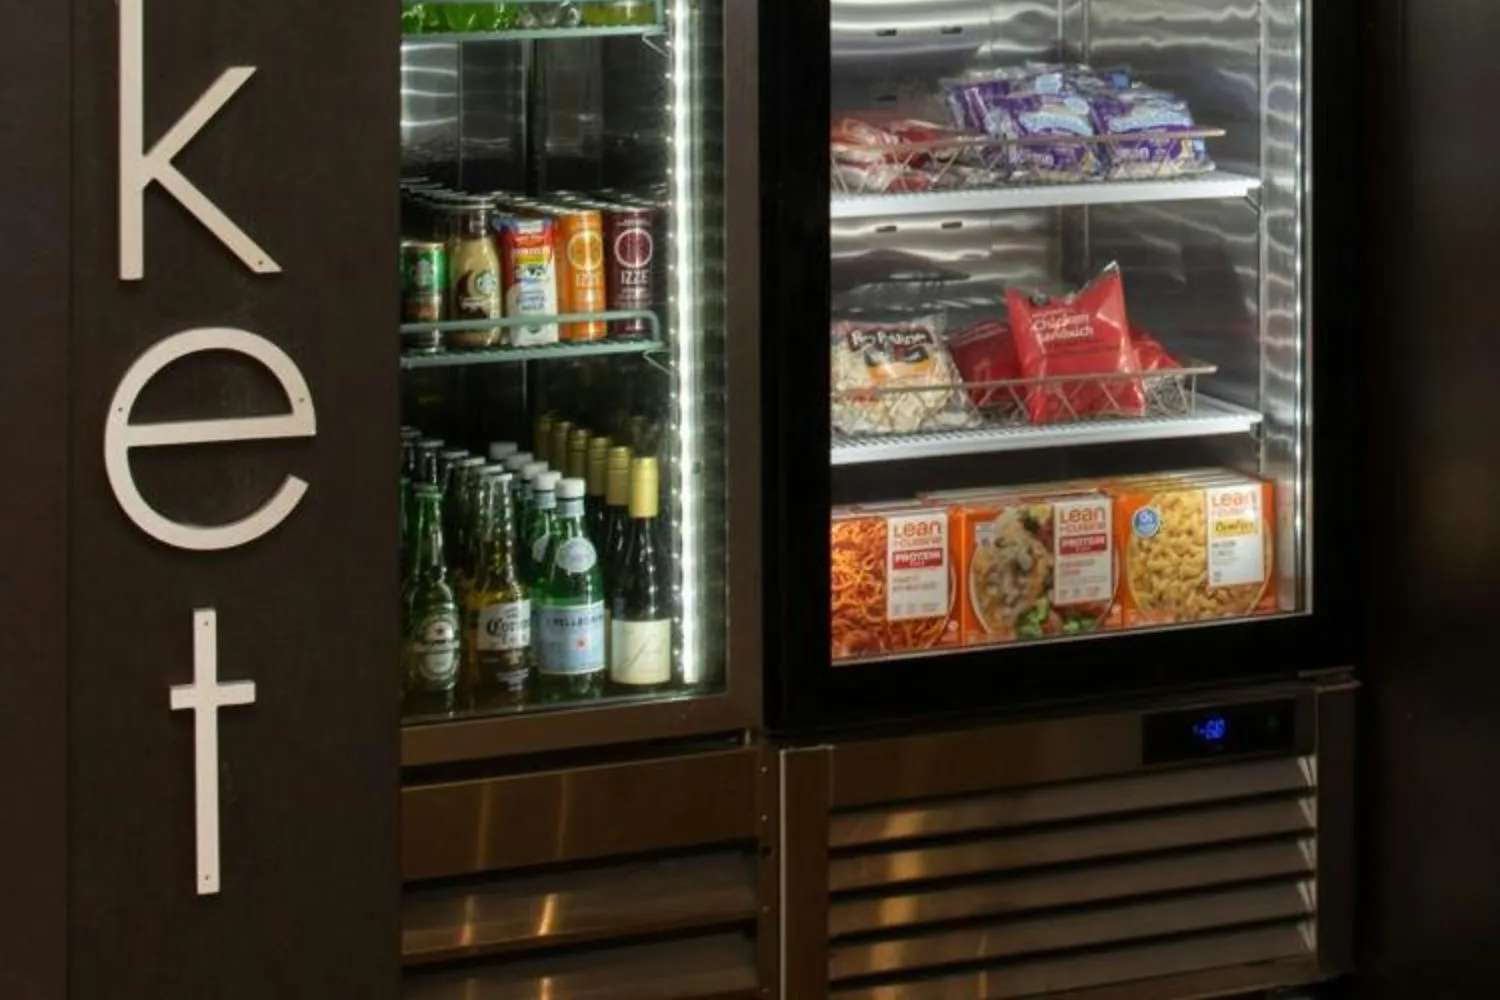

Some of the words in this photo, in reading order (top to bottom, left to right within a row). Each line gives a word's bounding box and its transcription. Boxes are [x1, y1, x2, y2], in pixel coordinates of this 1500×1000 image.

[621, 269, 649, 285] IZZE
[1060, 506, 1107, 523] Lean
[893, 520, 942, 539] Lean
